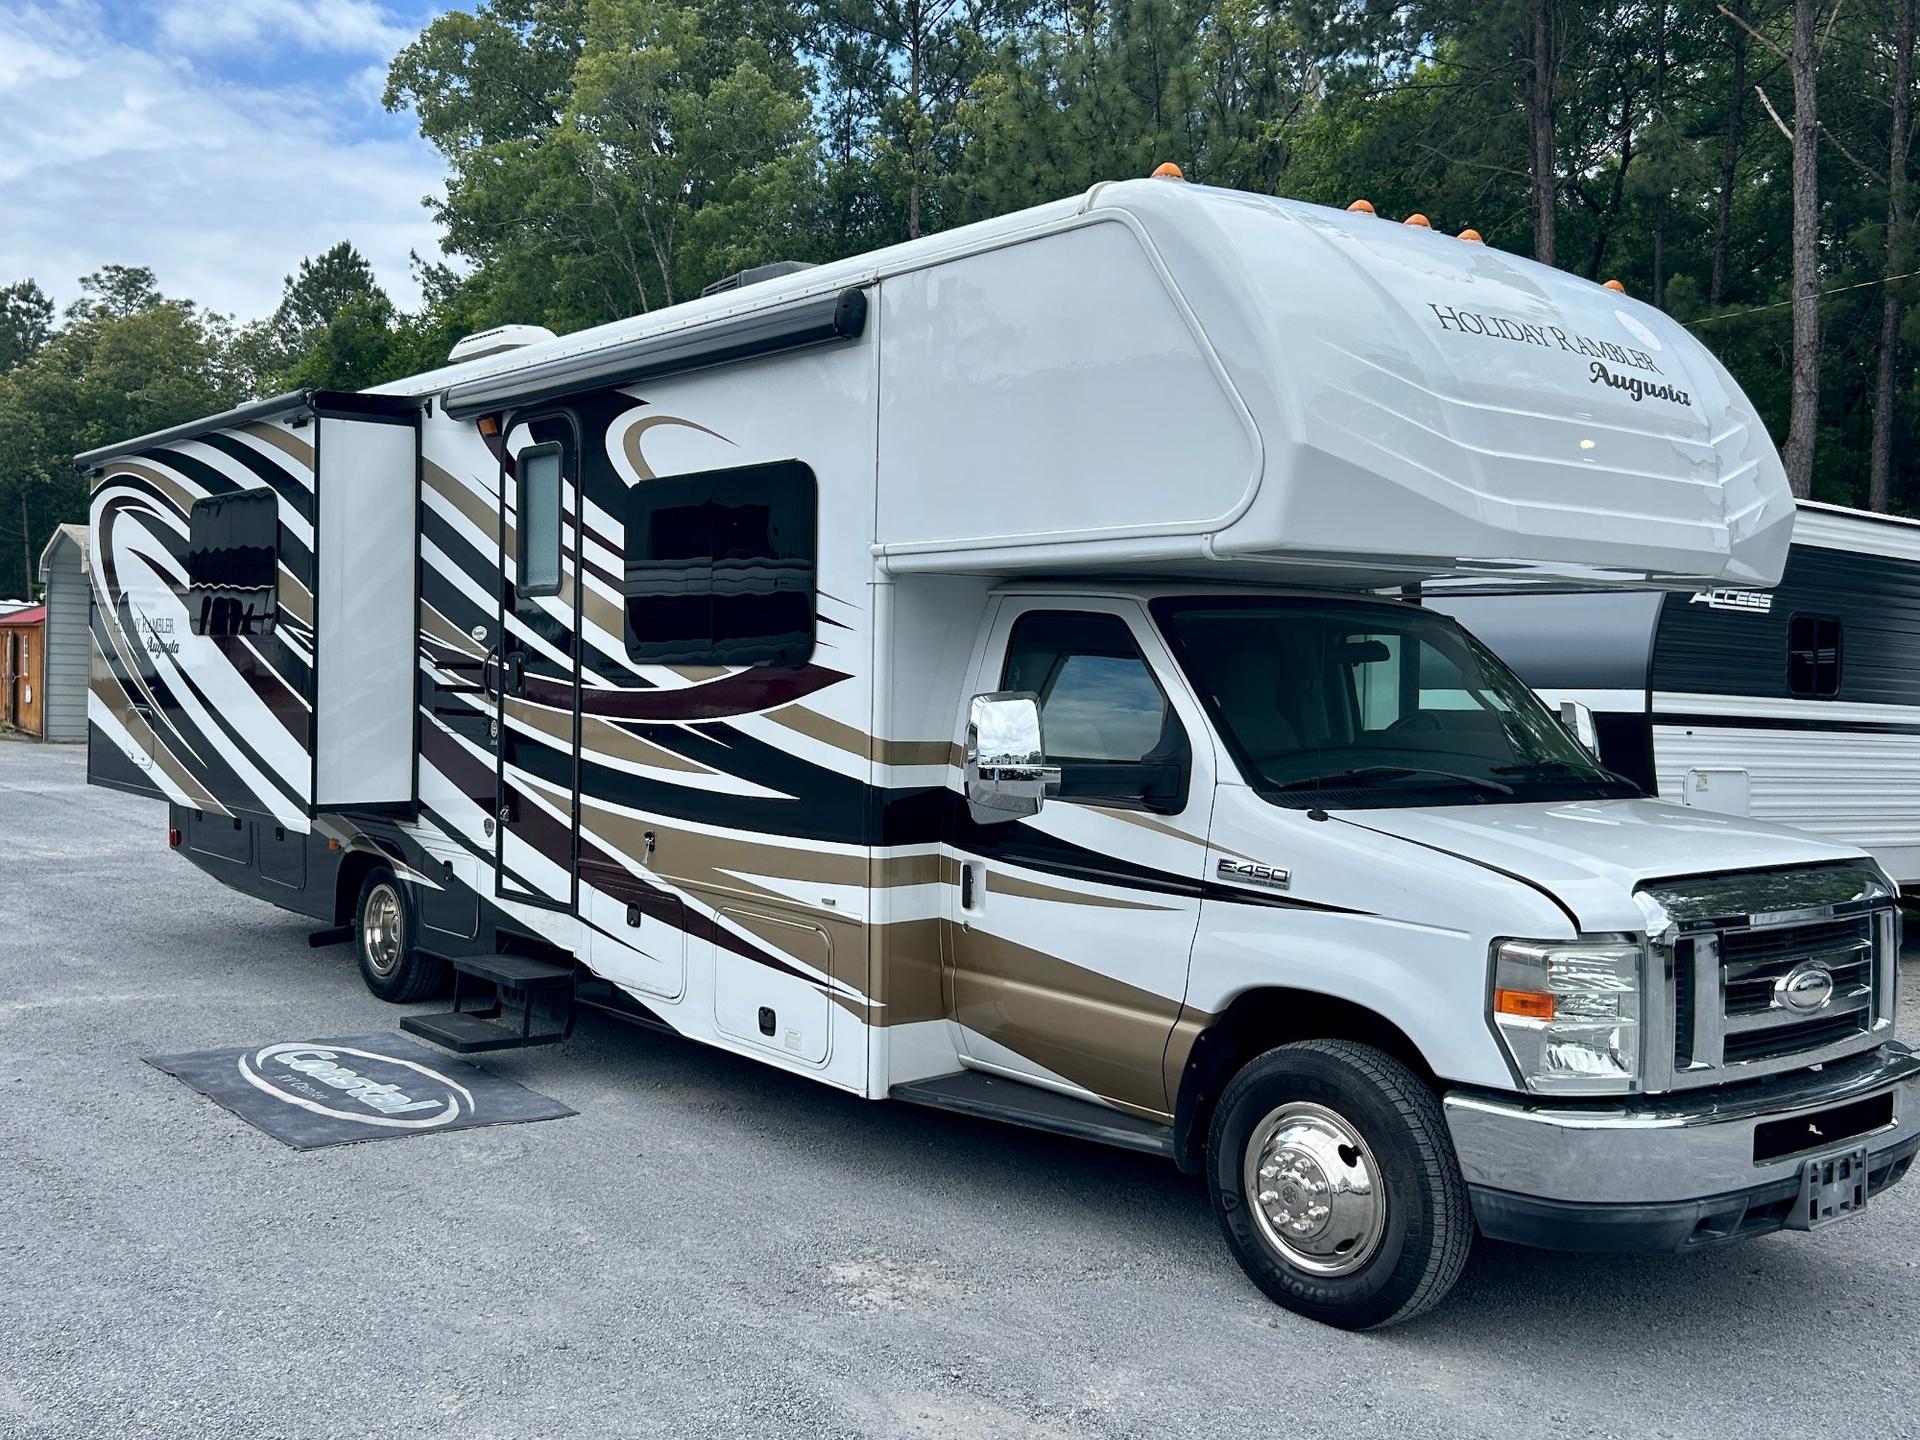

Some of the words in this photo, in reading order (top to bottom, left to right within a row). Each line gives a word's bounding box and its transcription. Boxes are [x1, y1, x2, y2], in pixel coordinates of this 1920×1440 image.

[1427, 303, 1551, 347] HOLIDAY
[1549, 325, 1664, 376] RAMBLER
[1589, 361, 1691, 406] Augusta
[1688, 590, 1773, 612] ACCESS
[274, 1050, 443, 1114] Coastal
